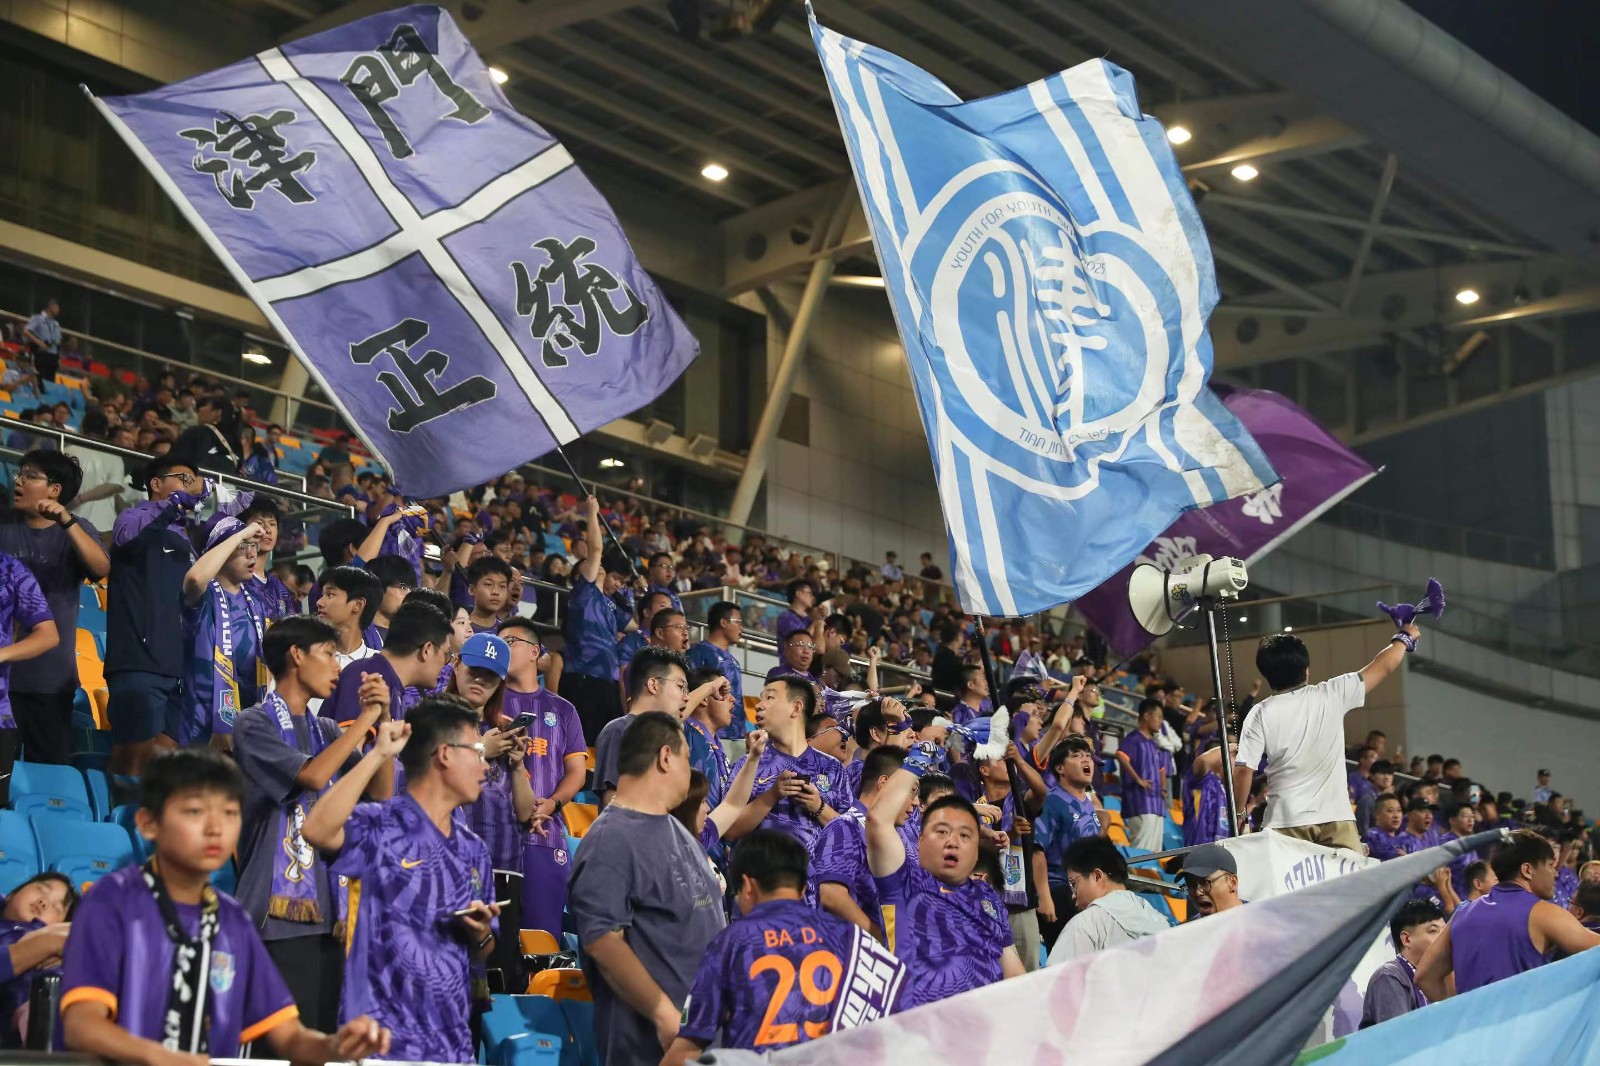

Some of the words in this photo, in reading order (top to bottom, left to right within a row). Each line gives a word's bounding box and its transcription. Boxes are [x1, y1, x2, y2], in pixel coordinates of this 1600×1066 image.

[951, 227, 984, 271] YOUTH
[980, 207, 1004, 231] FOR
[1007, 200, 1052, 217] YOUTH
[484, 641, 498, 660] LA
[527, 736, 548, 758] 津
[764, 928, 794, 948] BA
[801, 927, 824, 945] D.
[749, 949, 843, 1047] 29
